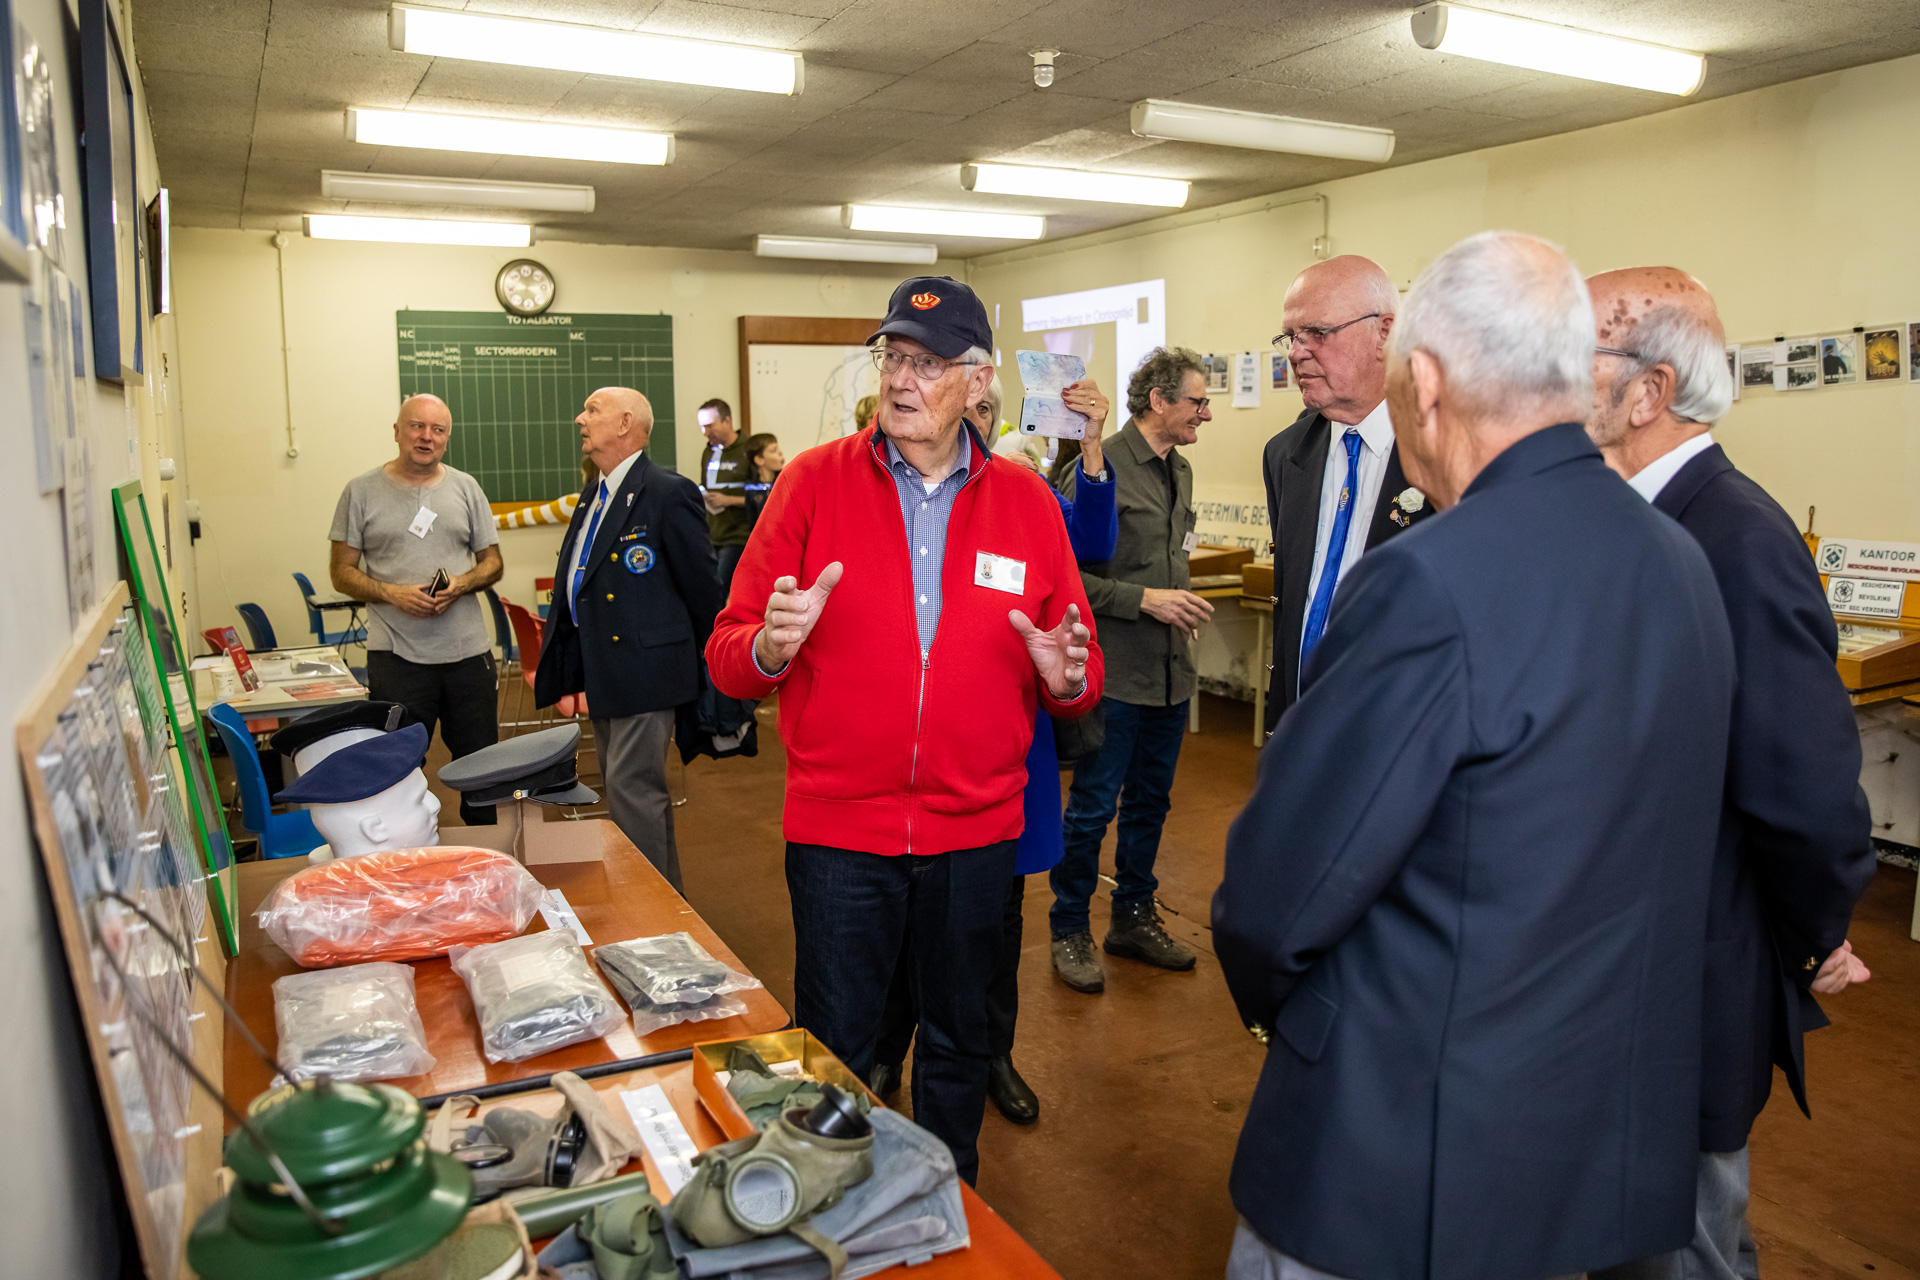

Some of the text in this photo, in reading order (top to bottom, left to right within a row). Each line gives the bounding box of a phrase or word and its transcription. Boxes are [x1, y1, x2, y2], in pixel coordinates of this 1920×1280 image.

[475, 346, 557, 356] SECTORGROEPEN
[1859, 549, 1916, 561] KANTOOR
[1847, 563, 1889, 572] BESCHERMING
[1861, 582, 1900, 590] BESCHERMING
[1858, 594, 1891, 602] BEVOLKING
[1861, 606, 1898, 615] VERZORGING
